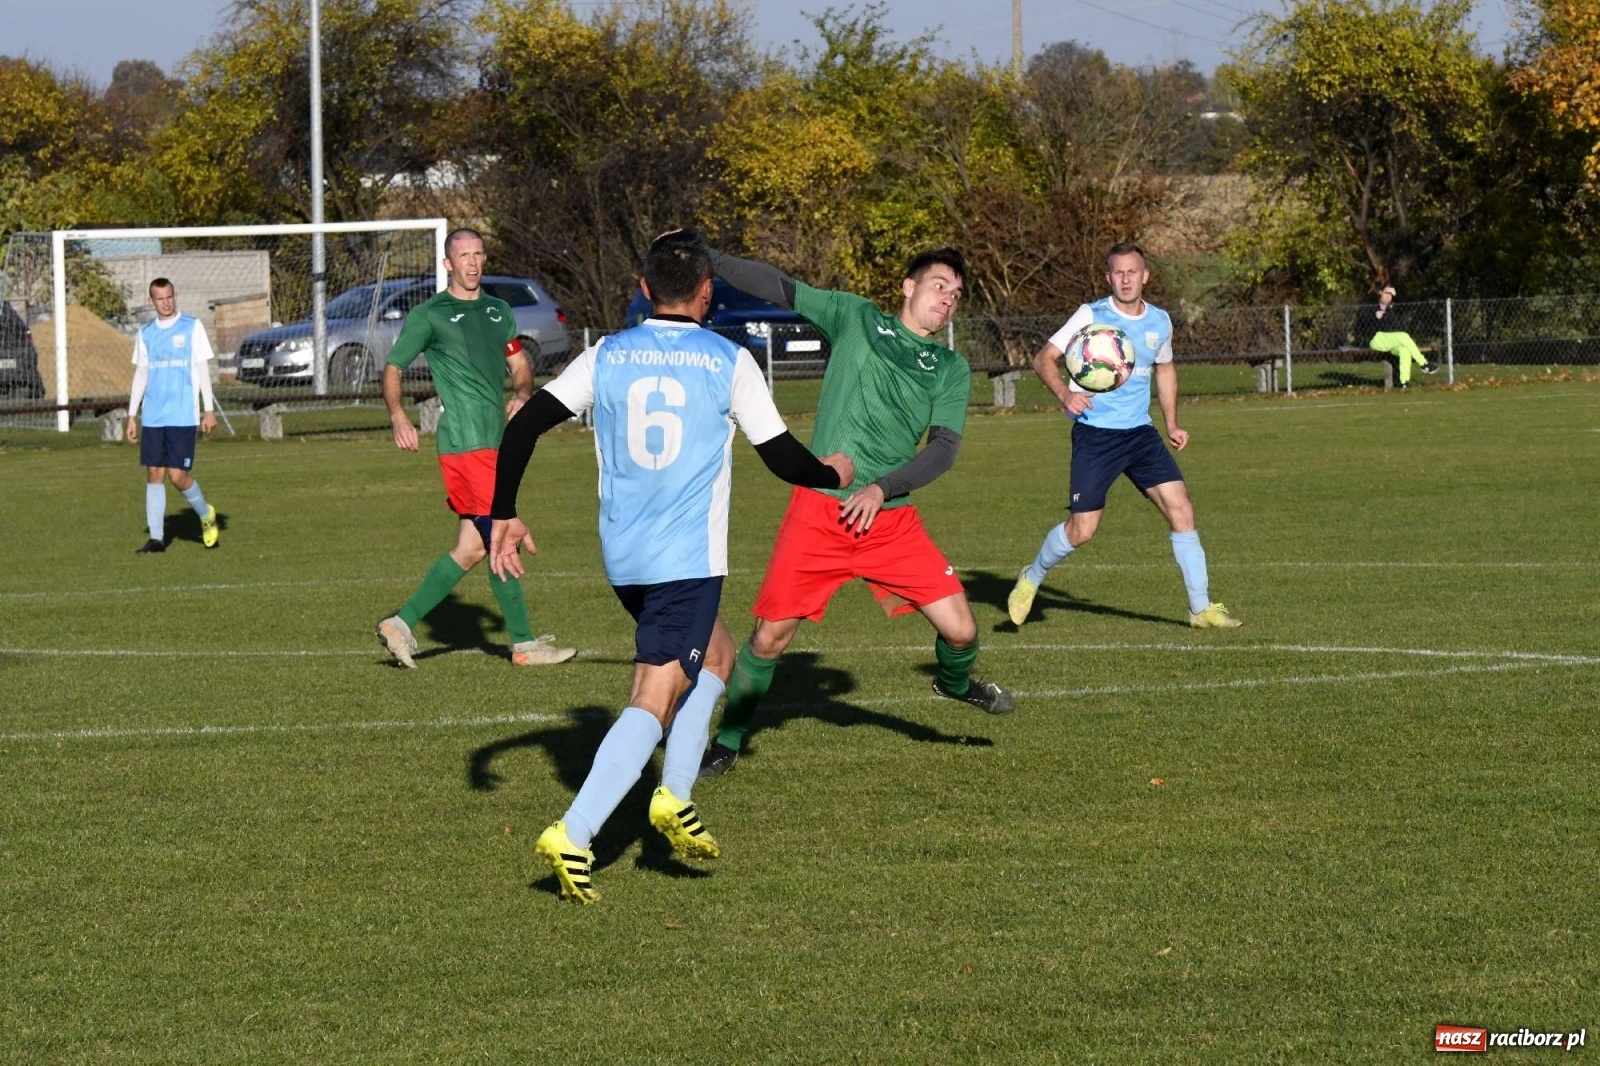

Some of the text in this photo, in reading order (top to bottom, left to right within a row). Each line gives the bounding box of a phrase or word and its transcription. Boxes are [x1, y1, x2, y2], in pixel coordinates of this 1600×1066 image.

[607, 350, 722, 373] KS KORNOWAC
[627, 376, 686, 470] 6
